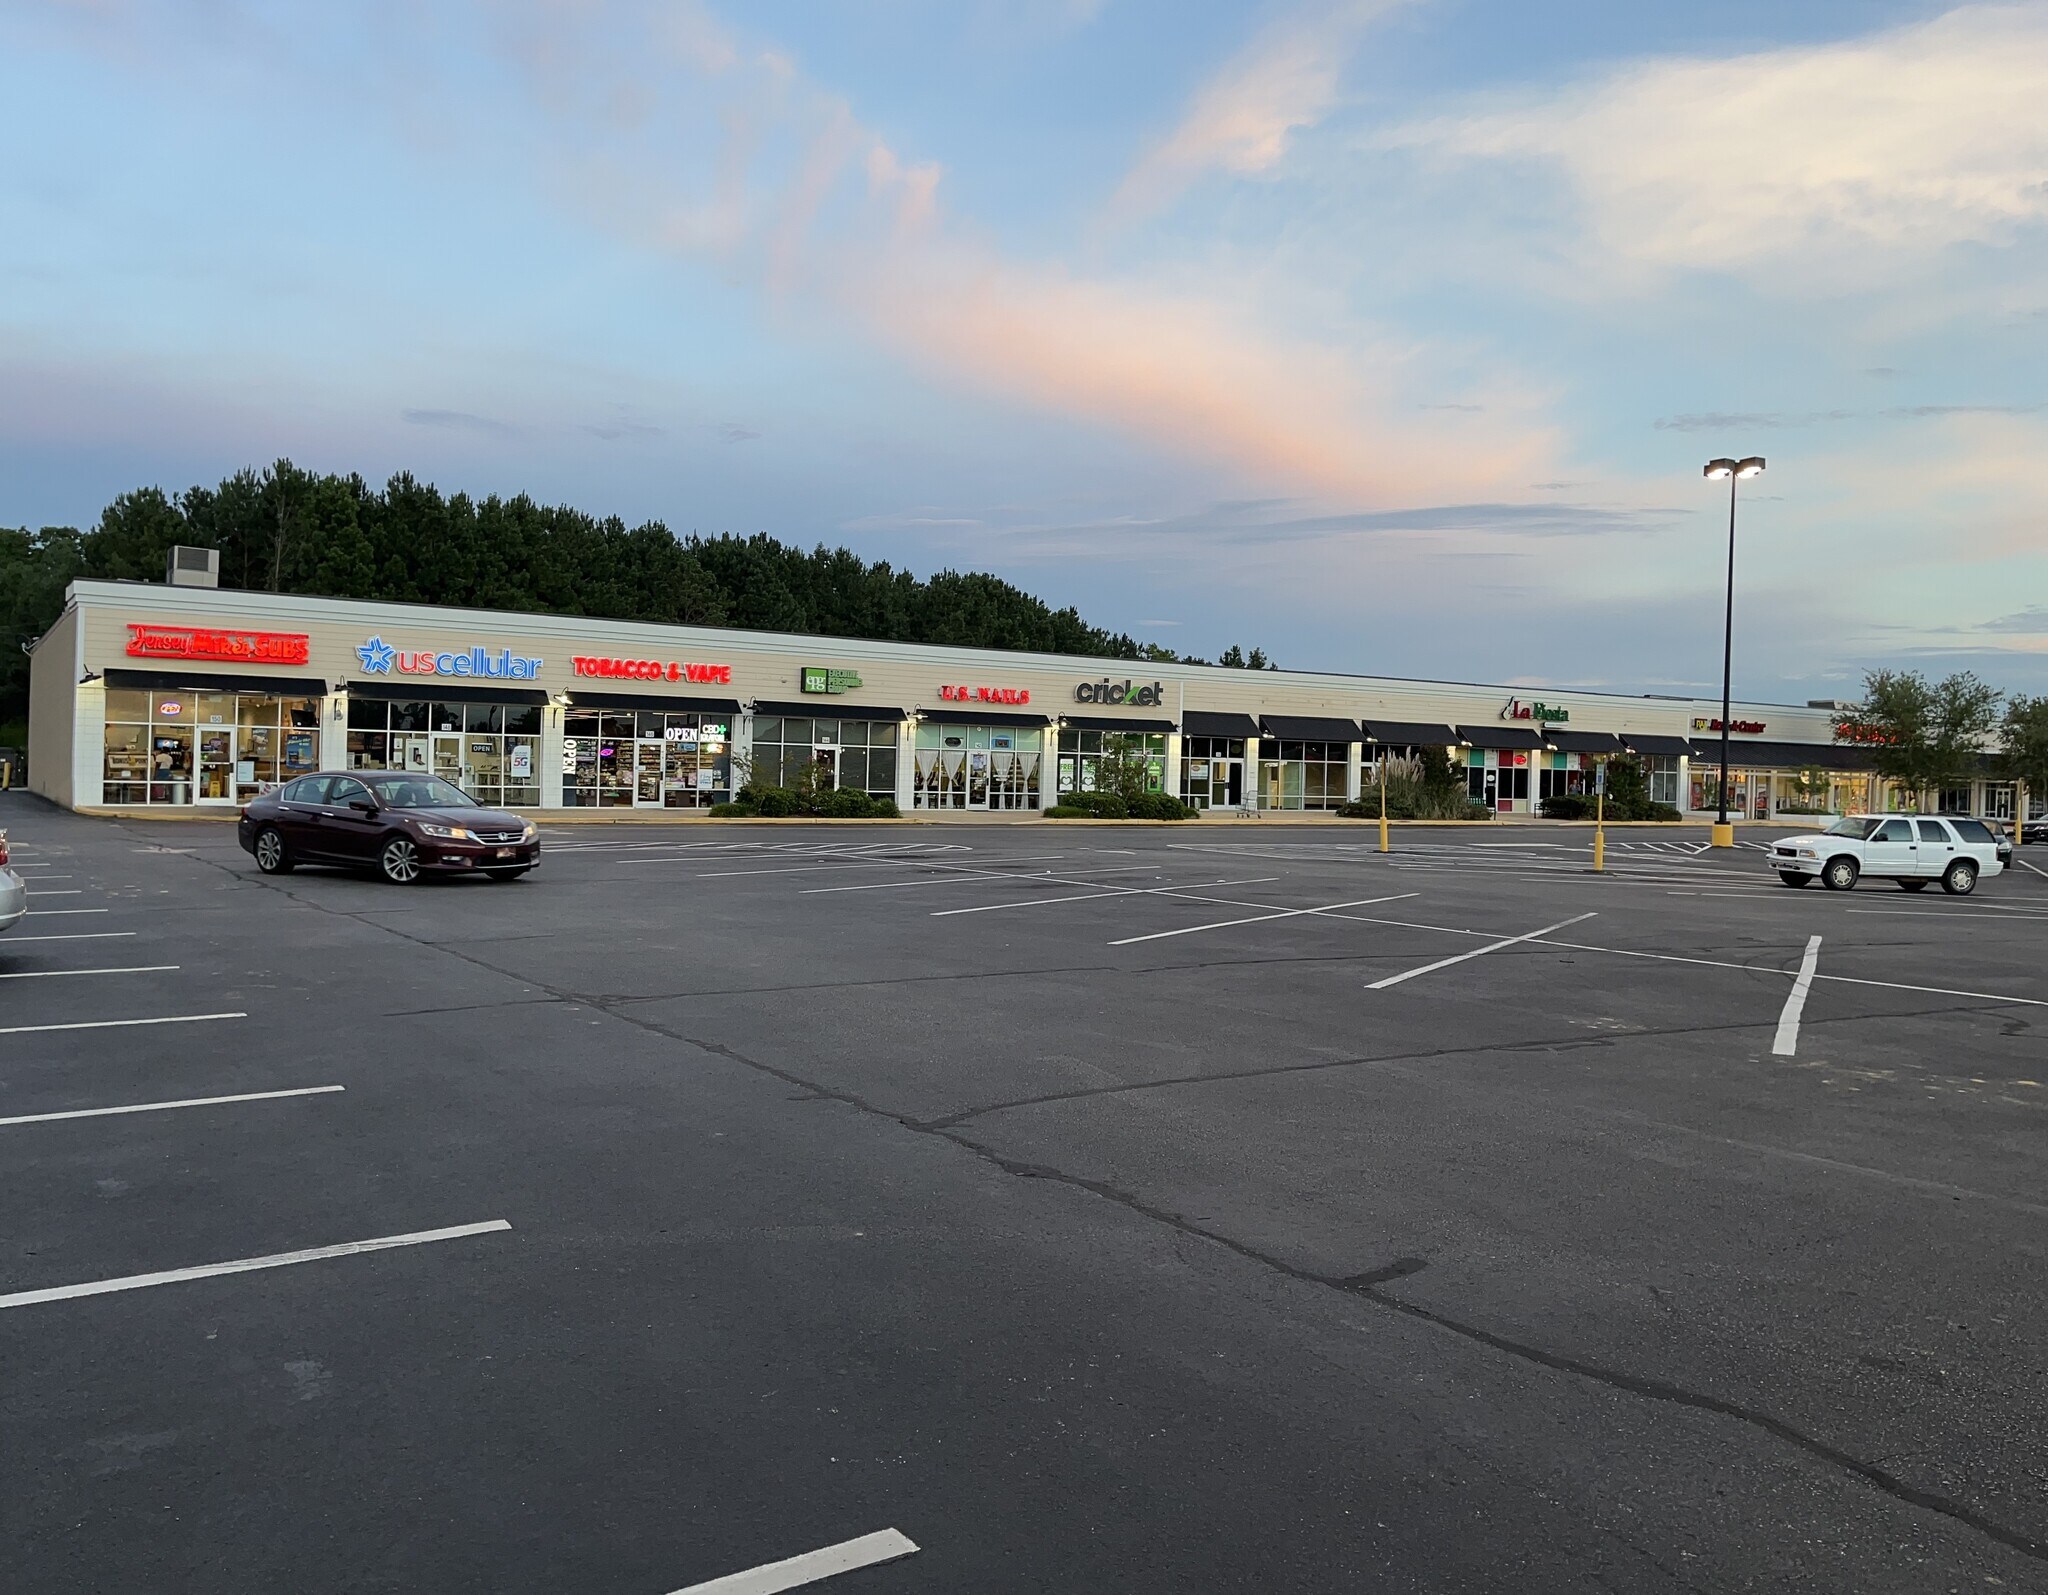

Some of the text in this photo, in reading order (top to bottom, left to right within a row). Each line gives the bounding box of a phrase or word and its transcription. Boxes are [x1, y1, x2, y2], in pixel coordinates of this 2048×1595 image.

[571, 655, 732, 684] TOBACCO & VAPE
[976, 687, 1030, 705] NAILS
[1075, 677, 1164, 706] cricket
[1513, 700, 1532, 720] La
[666, 727, 699, 741] OPEN
[513, 756, 529, 767] 5G
[562, 739, 577, 774] OPEN
